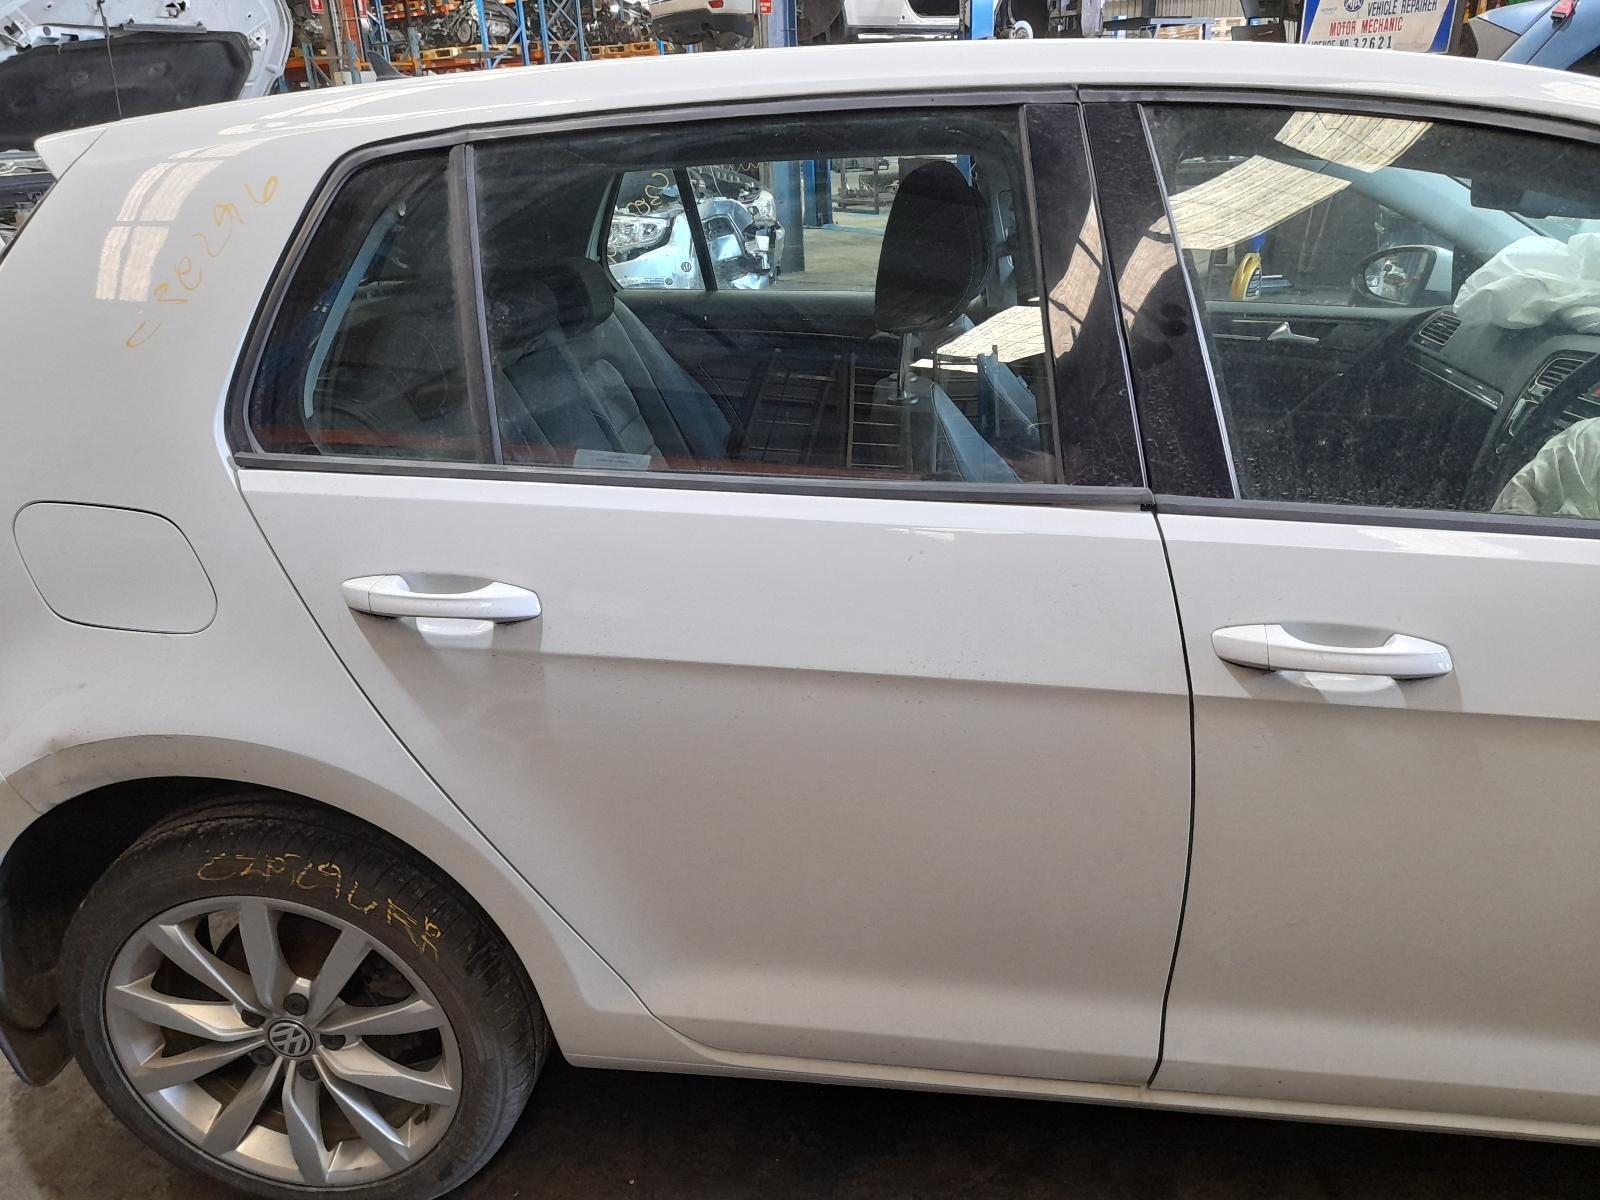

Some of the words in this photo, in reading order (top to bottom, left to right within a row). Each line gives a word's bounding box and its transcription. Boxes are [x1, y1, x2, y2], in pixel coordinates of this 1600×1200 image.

[1367, 0, 1398, 16] VEHICLE
[1401, 0, 1437, 13] REPAIRER
[1330, 20, 1357, 37] MOTOR
[1361, 16, 1404, 34] MECHANIC
[1353, 35, 1392, 49] 32621
